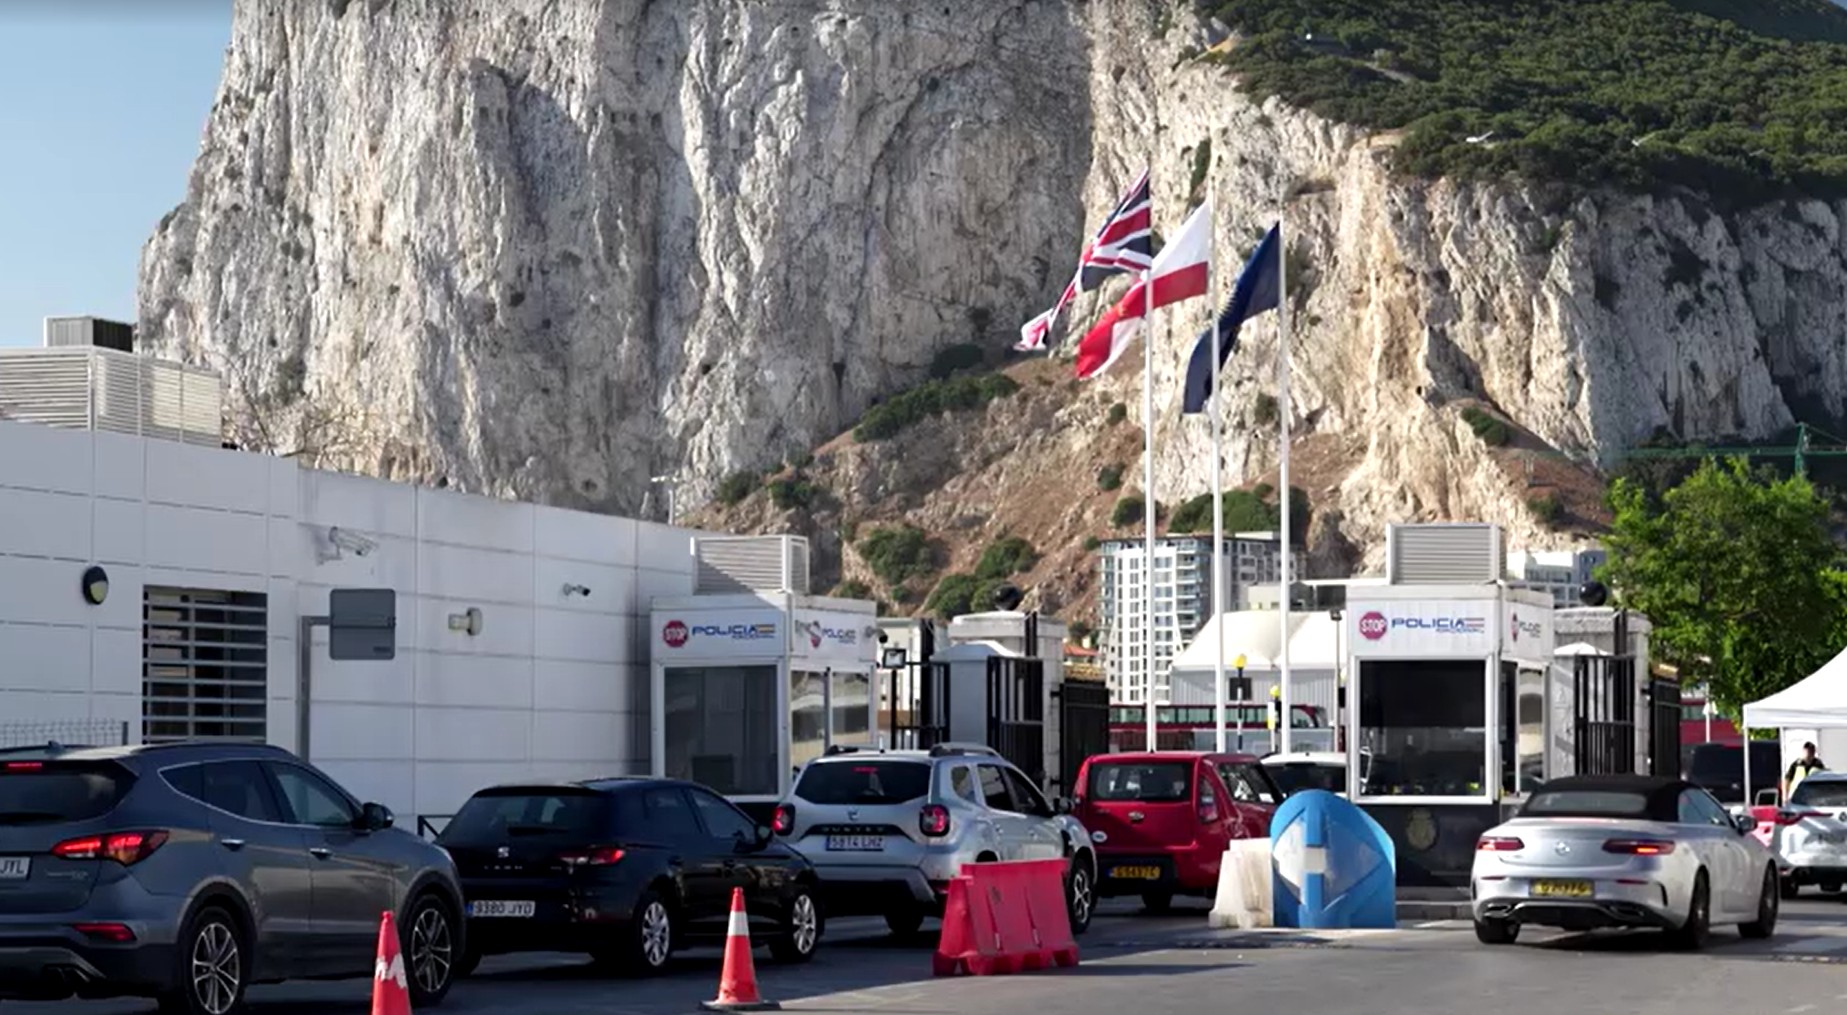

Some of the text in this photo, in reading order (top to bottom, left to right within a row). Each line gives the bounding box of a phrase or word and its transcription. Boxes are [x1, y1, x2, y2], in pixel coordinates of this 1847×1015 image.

[1360, 617, 1465, 632] STOP POLICIA
[664, 625, 757, 641] STOP POLICIA
